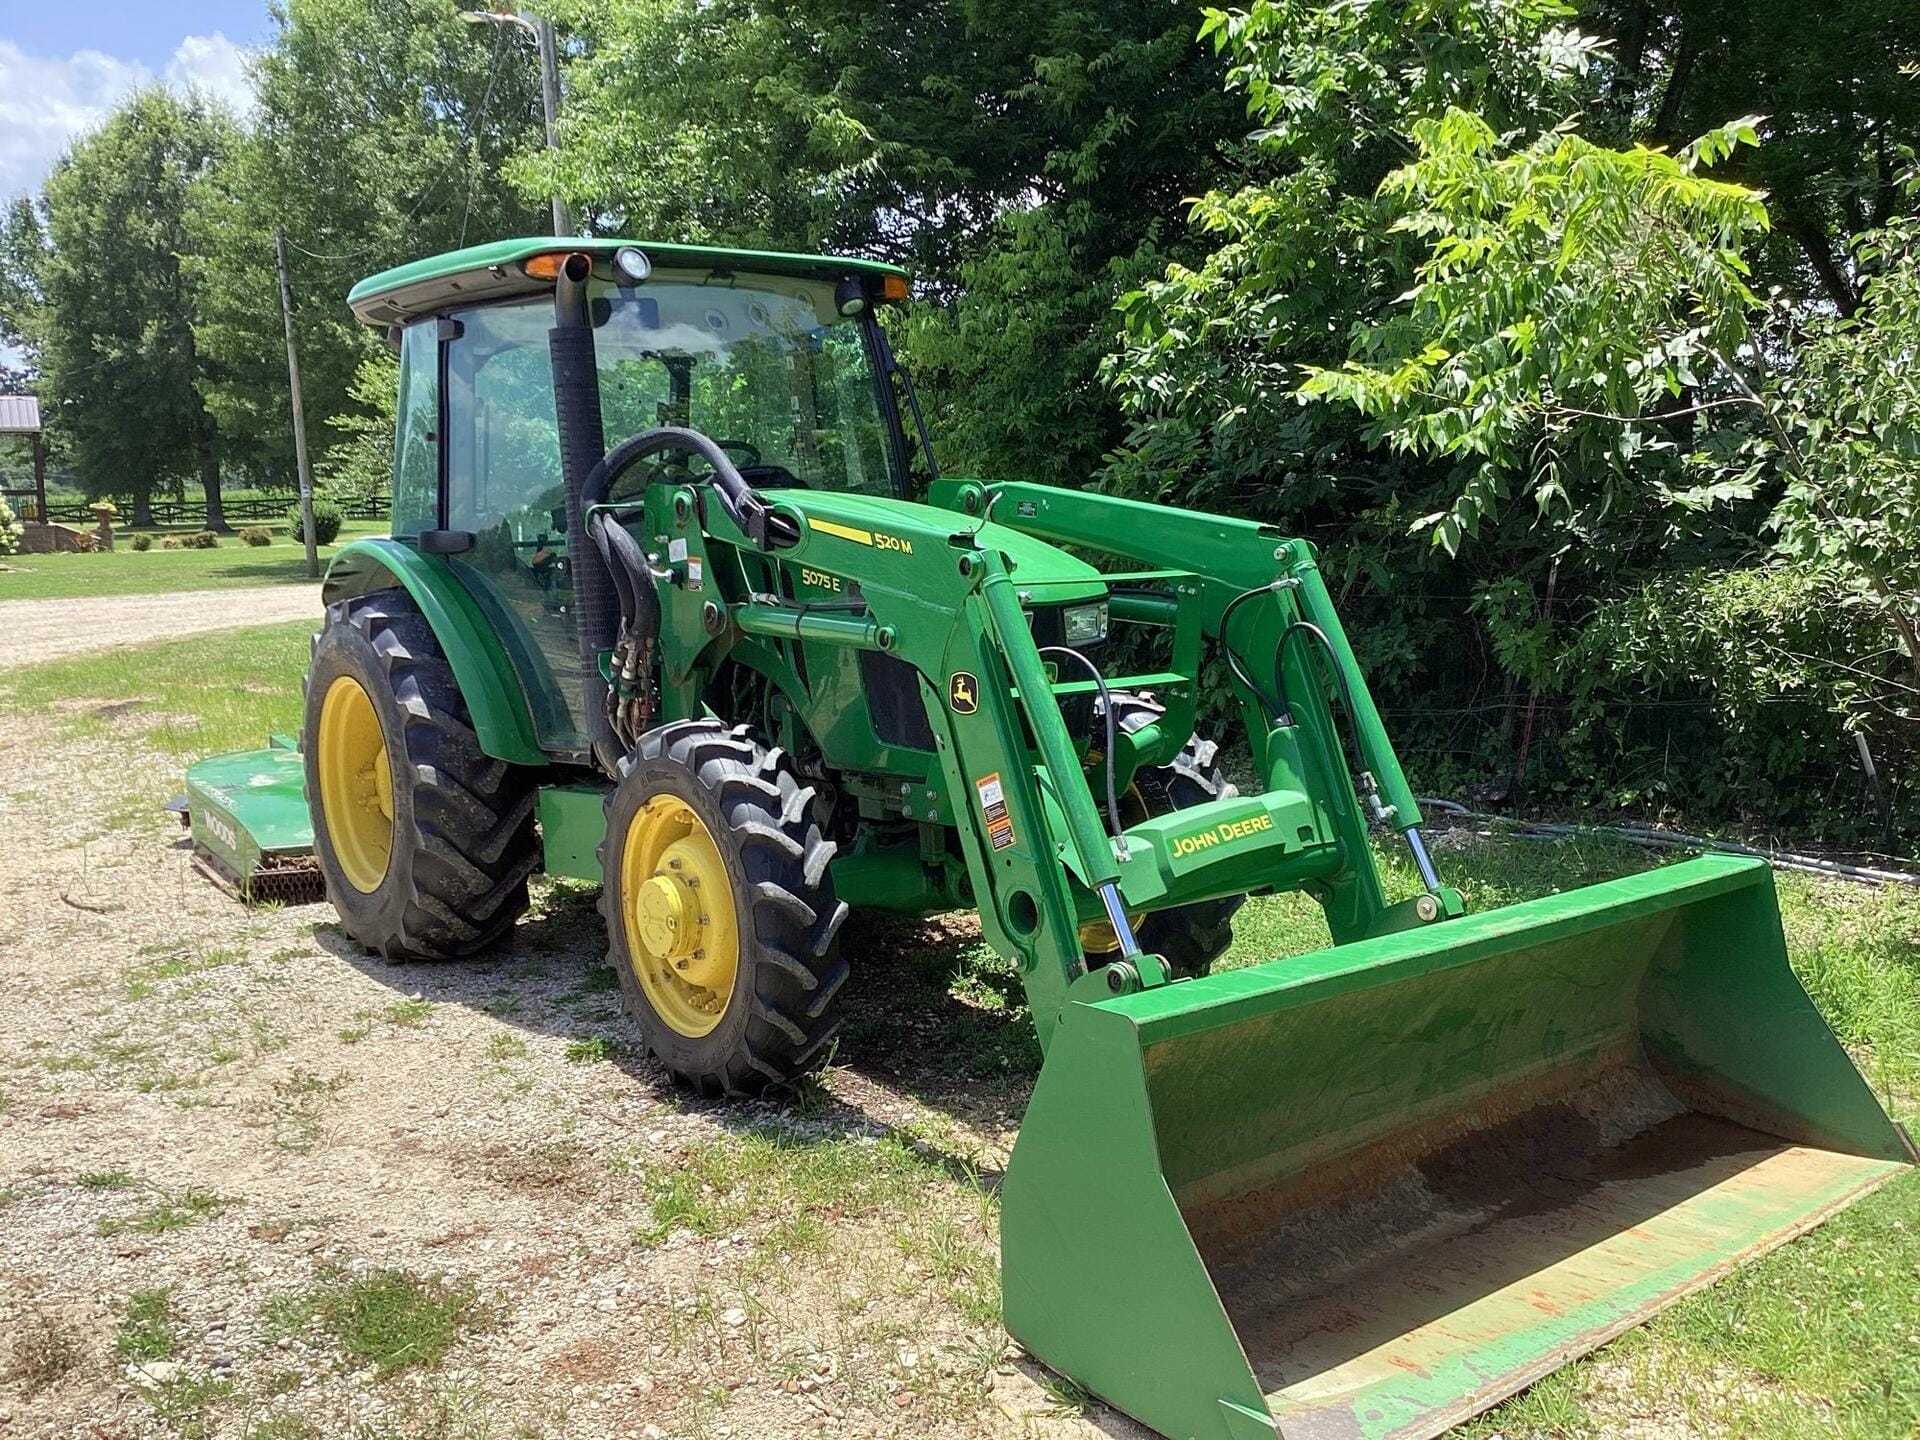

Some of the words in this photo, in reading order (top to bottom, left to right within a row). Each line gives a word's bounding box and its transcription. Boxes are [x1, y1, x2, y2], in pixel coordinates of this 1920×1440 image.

[874, 533, 900, 550] 520
[901, 539, 913, 555] M
[802, 568, 831, 590] 5075
[1173, 830, 1220, 859] JOHN
[1217, 814, 1273, 842] DEERE
